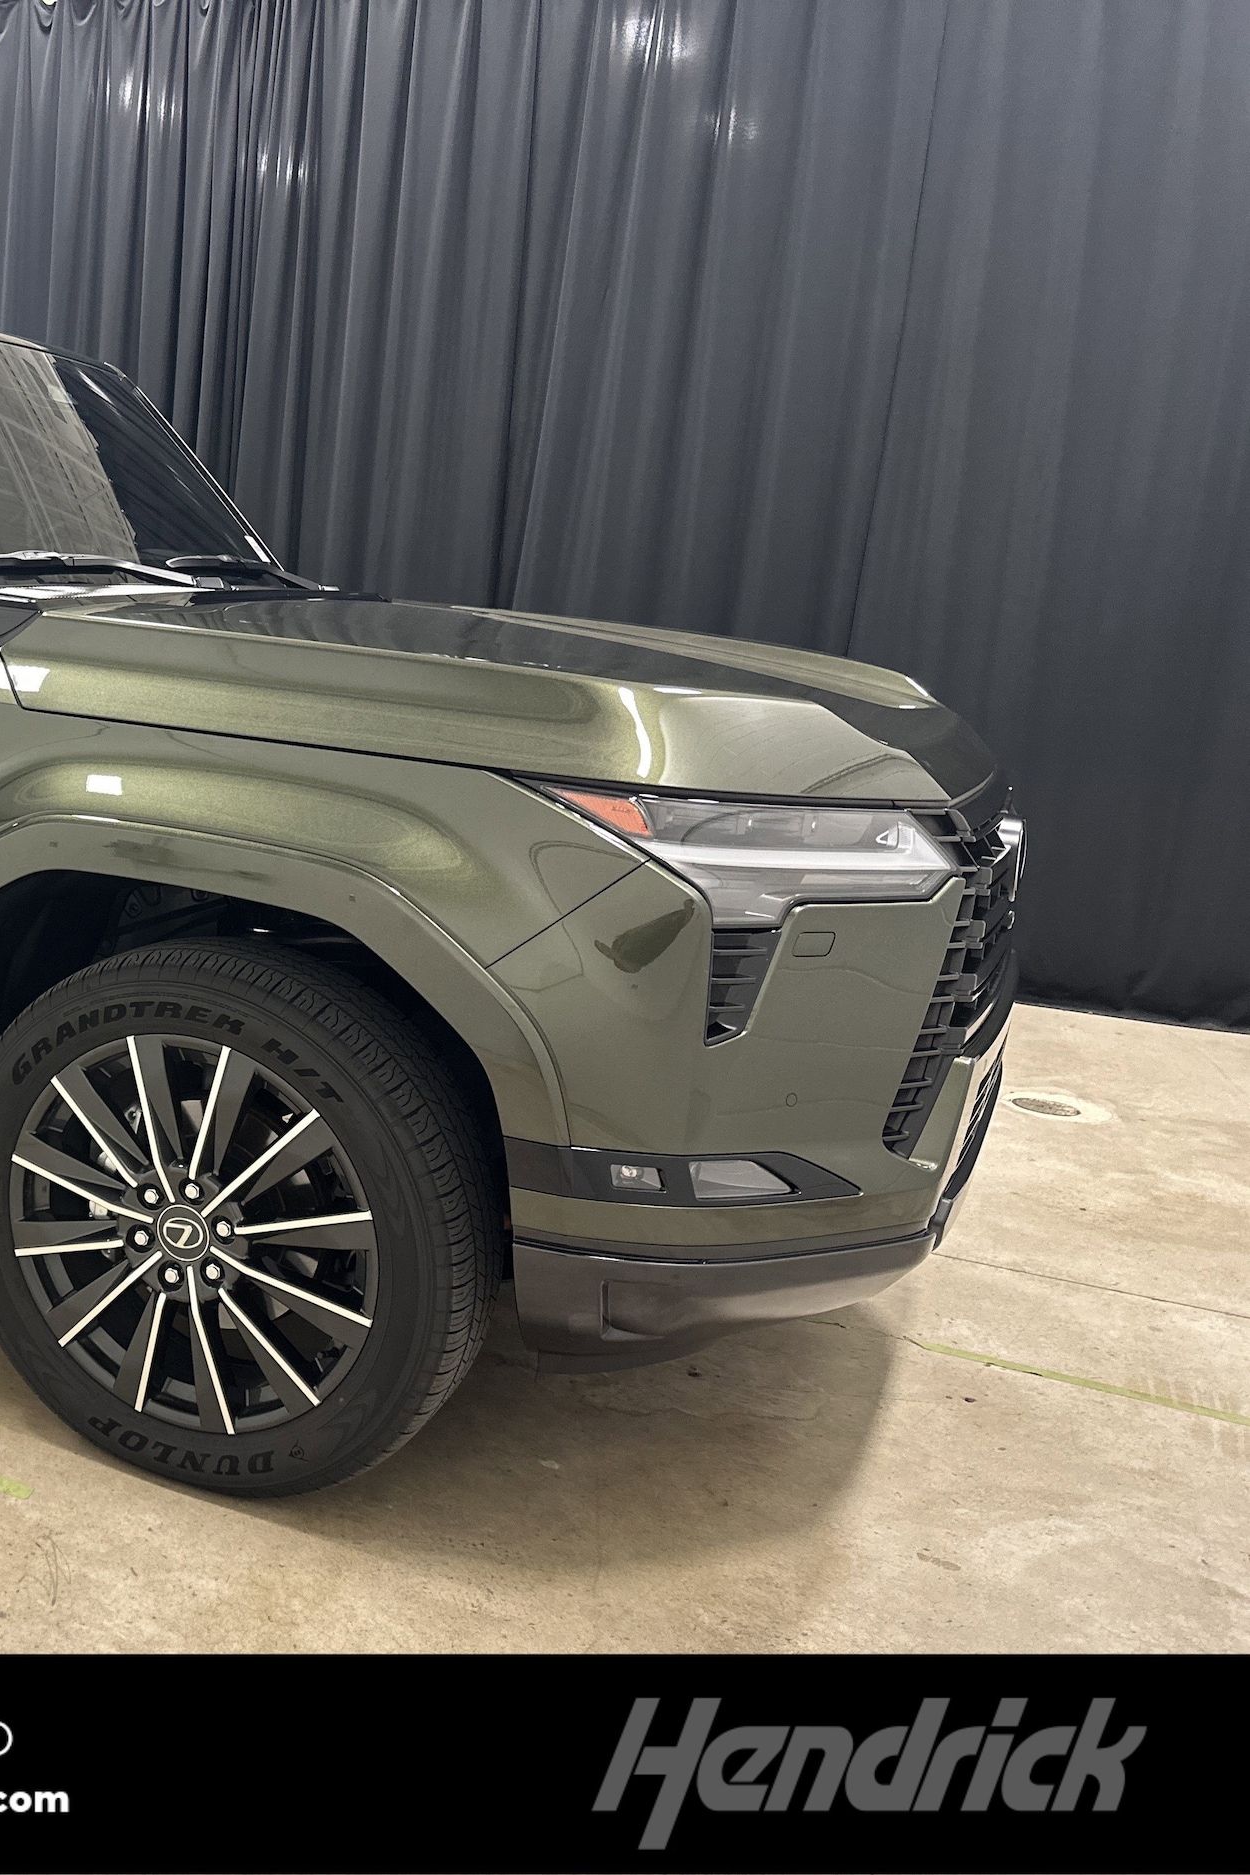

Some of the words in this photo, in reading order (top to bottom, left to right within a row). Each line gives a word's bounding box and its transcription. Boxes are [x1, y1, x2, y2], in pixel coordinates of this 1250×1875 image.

[12, 1000, 245, 1085] GRANDTREK
[260, 1037, 345, 1104] H/T
[87, 1415, 275, 1476] DUNLOP
